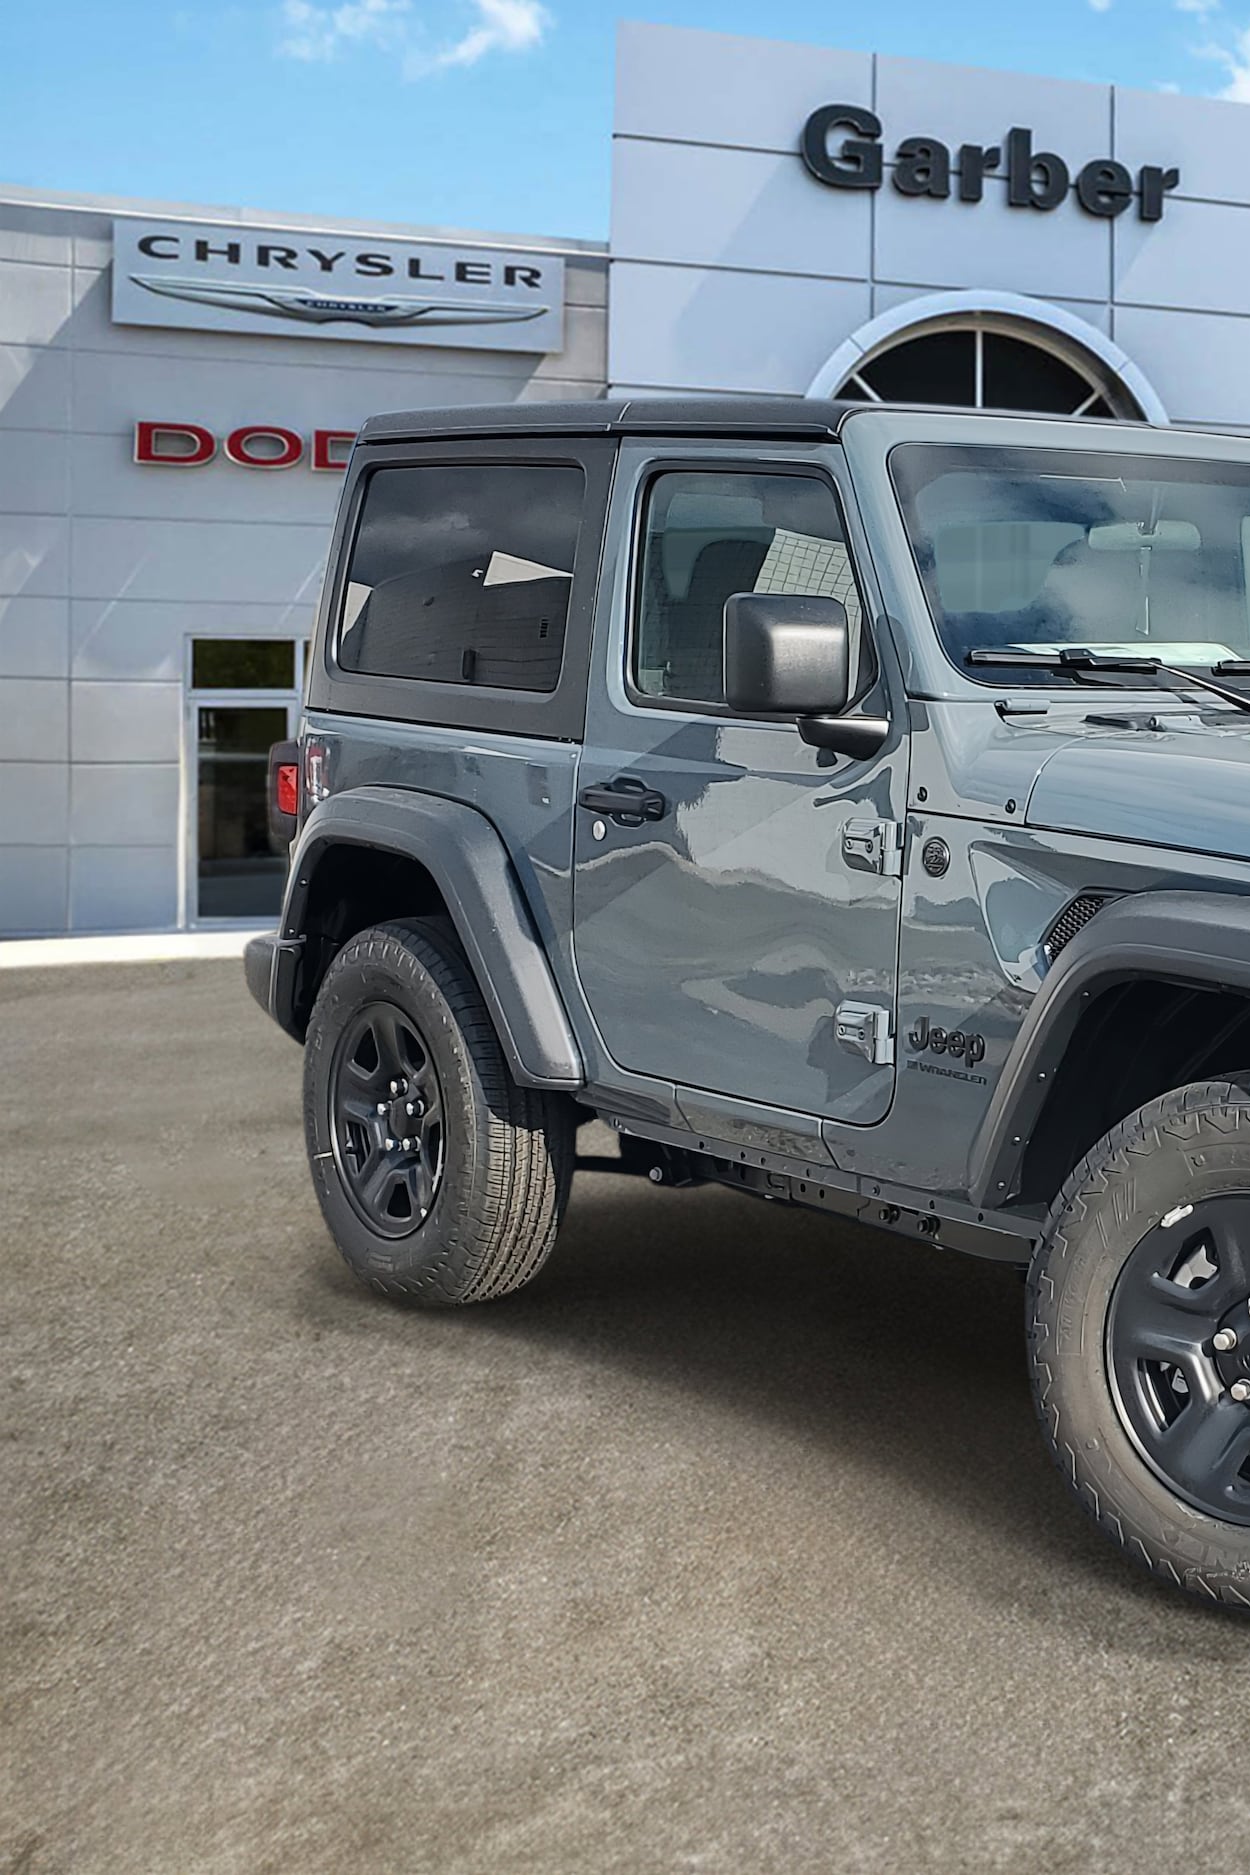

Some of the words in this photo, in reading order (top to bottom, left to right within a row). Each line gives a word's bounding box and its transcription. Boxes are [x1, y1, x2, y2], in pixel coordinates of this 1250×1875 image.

[801, 104, 1180, 222] Garber
[137, 234, 542, 288] CHRYSLER
[134, 421, 358, 472] DOD
[908, 1016, 985, 1067] Jeep
[919, 1062, 987, 1085] WRANGLER
